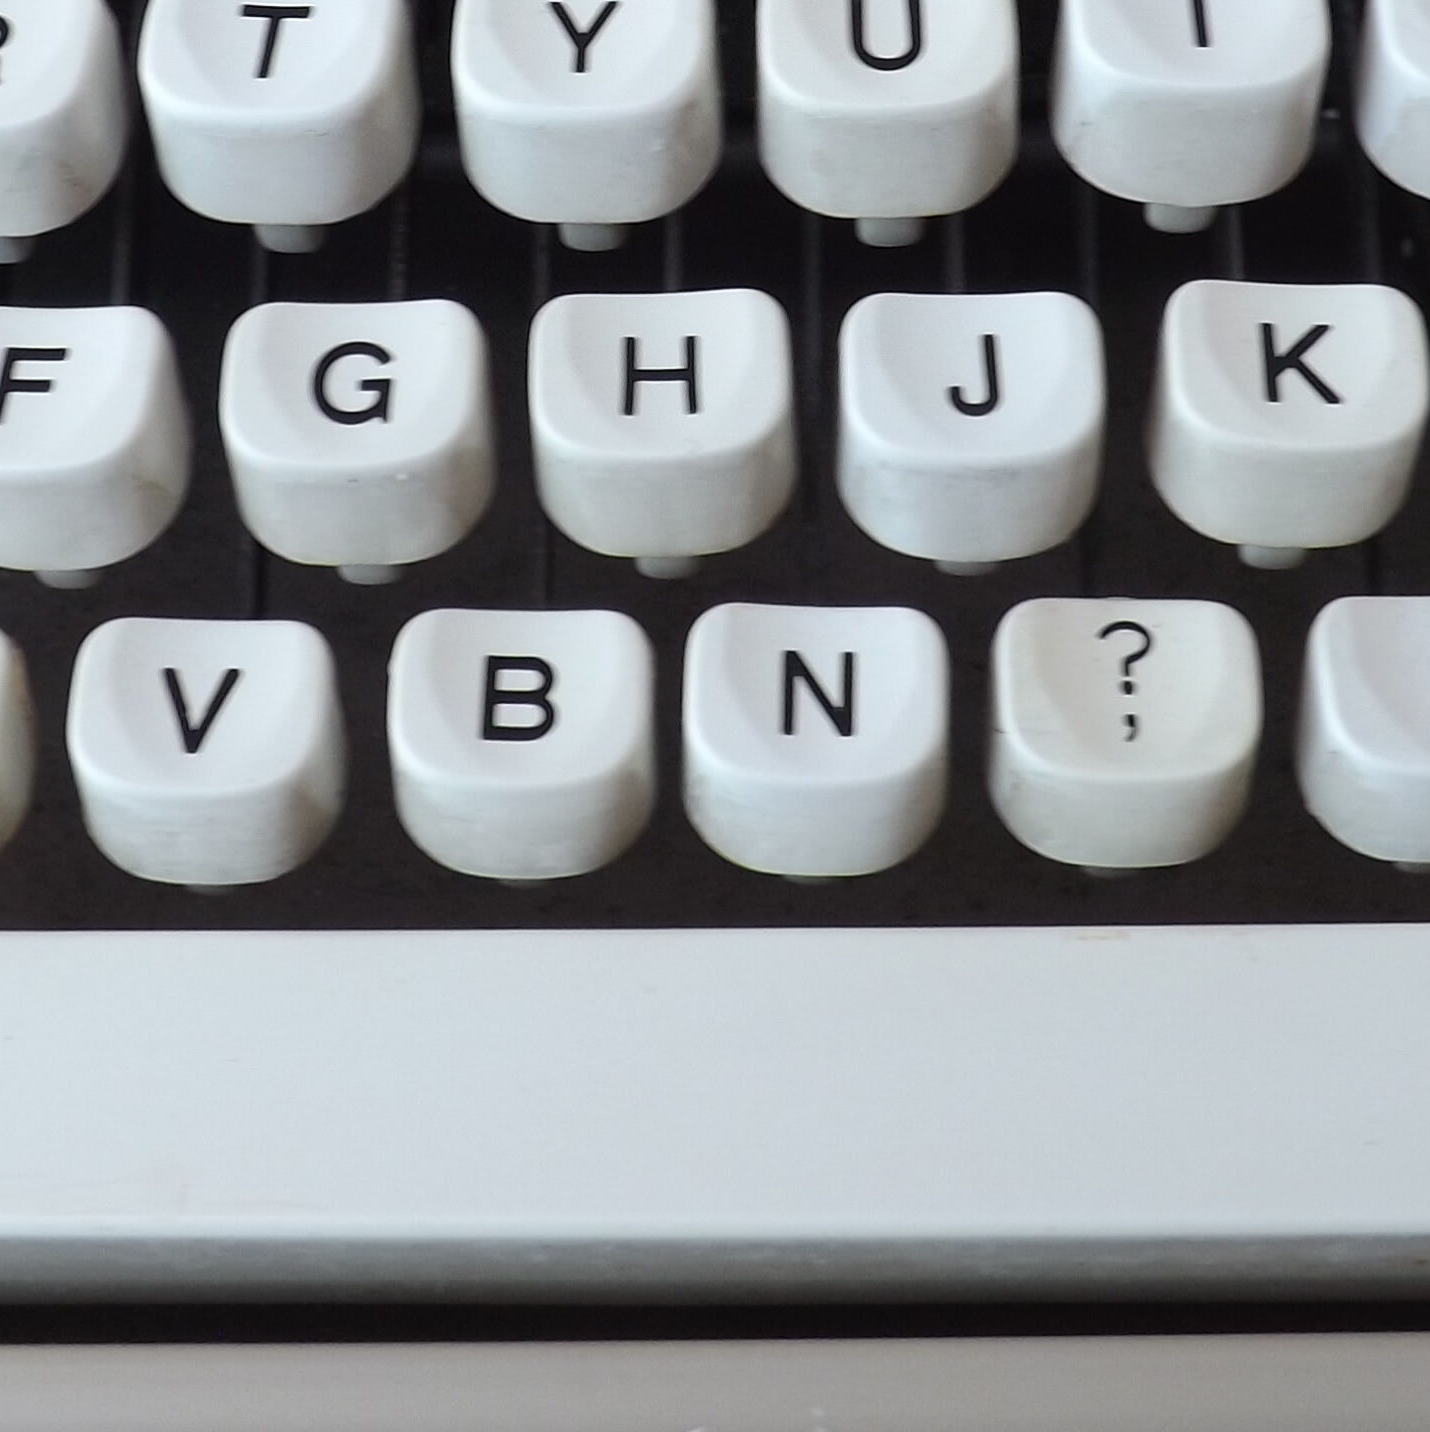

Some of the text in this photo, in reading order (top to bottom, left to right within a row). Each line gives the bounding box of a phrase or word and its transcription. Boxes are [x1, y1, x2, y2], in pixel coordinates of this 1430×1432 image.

[239, 3, 313, 80] T
[546, 0, 620, 75] Y
[309, 340, 394, 427] G
[620, 334, 700, 418] H
[946, 332, 1002, 418] J
[1257, 321, 1343, 406] K
[478, 653, 558, 743] B
[779, 648, 856, 739] N
[1096, 619, 1154, 697] ?
[160, 666, 242, 756] V
